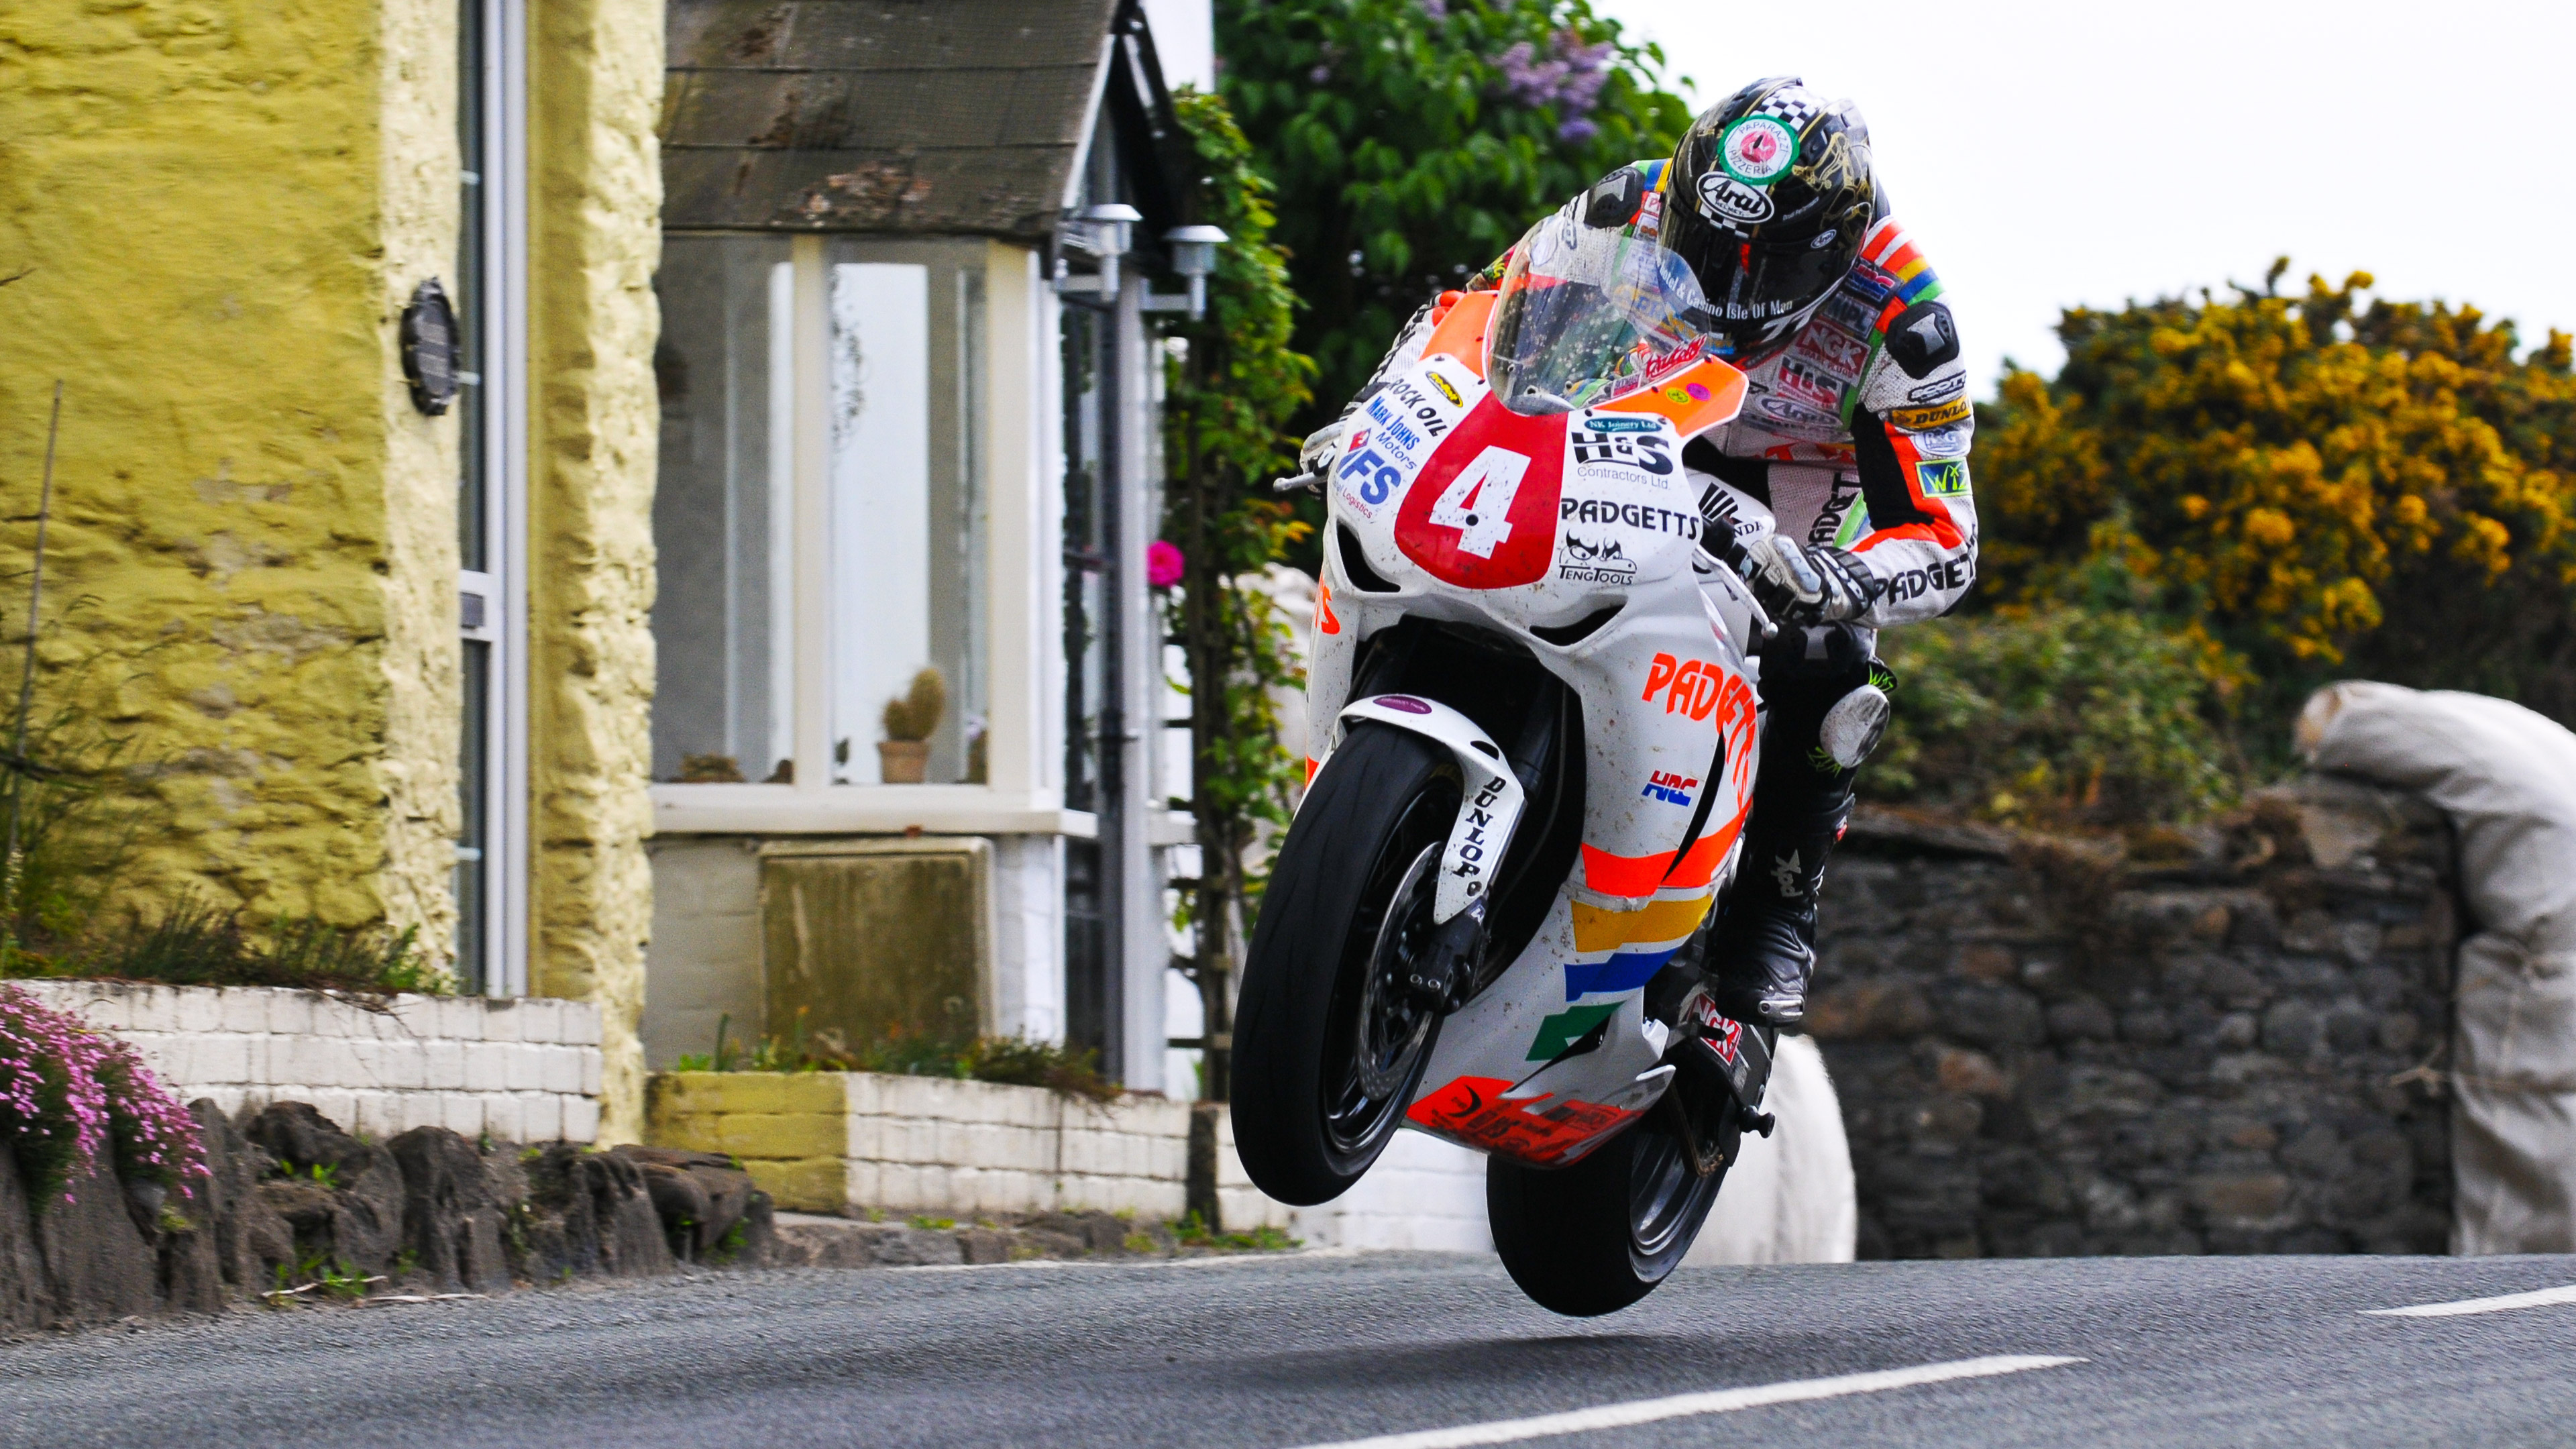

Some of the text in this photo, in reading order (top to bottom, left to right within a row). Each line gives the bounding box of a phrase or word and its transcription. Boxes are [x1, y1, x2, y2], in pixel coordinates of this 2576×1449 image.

[1738, 121, 1789, 153] PAPARAZZI
[1729, 149, 1773, 175] PIZZERIA
[1701, 179, 1764, 214] Arai
[1686, 290, 1723, 317] Casino
[1726, 303, 1749, 320] Isle
[1752, 303, 1767, 319] Of
[1770, 299, 1793, 315] Man
[1802, 324, 1862, 370] NGK
[1366, 396, 1421, 451] MARK JOHNS
[1388, 378, 1426, 409] ROCK
[1416, 407, 1448, 437] OIL
[1589, 420, 1606, 429] NK
[1915, 401, 1967, 423] DUNLO
[1375, 431, 1418, 470] Motors
[1571, 431, 1674, 476] H&S
[1577, 466, 1648, 485] Contractors
[1342, 488, 1373, 519] Logistics
[1428, 445, 1532, 559] 4
[1560, 497, 1700, 540] PADGETTS
[1733, 521, 1764, 538] NDA
[1642, 769, 1699, 807] HRC
[1451, 775, 1507, 878] DUNLOP
